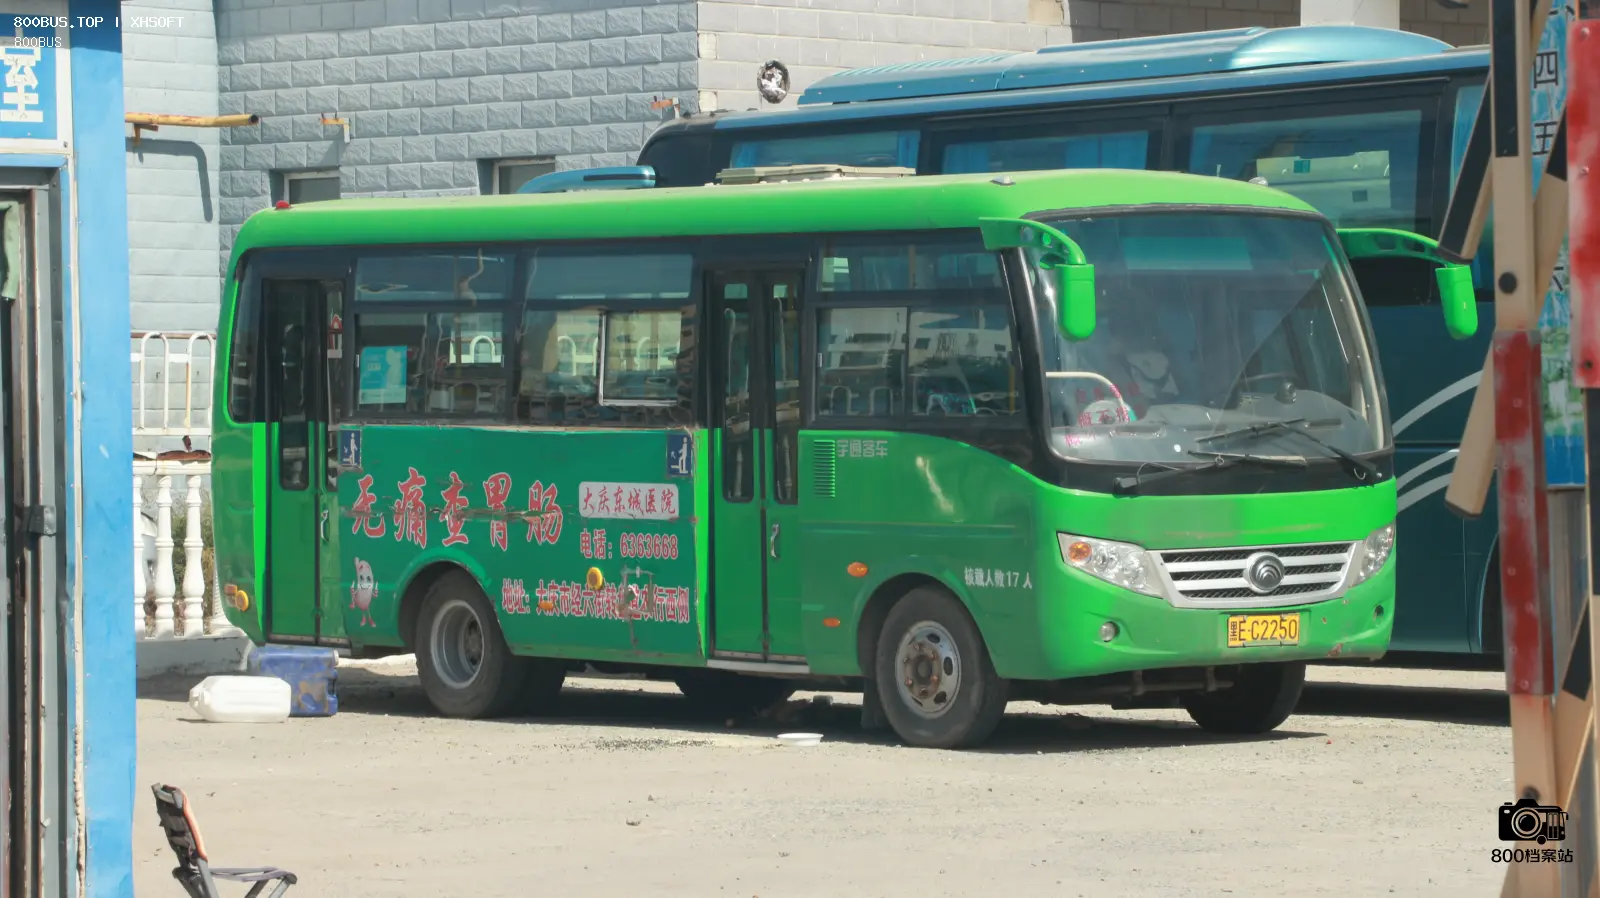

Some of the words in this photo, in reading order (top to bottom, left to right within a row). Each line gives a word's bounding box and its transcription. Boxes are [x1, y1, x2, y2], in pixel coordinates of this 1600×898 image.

[836, 439, 889, 458] 宇通客车
[351, 466, 564, 552] 无痛查胃肠
[582, 484, 676, 516] 大庆东城医院
